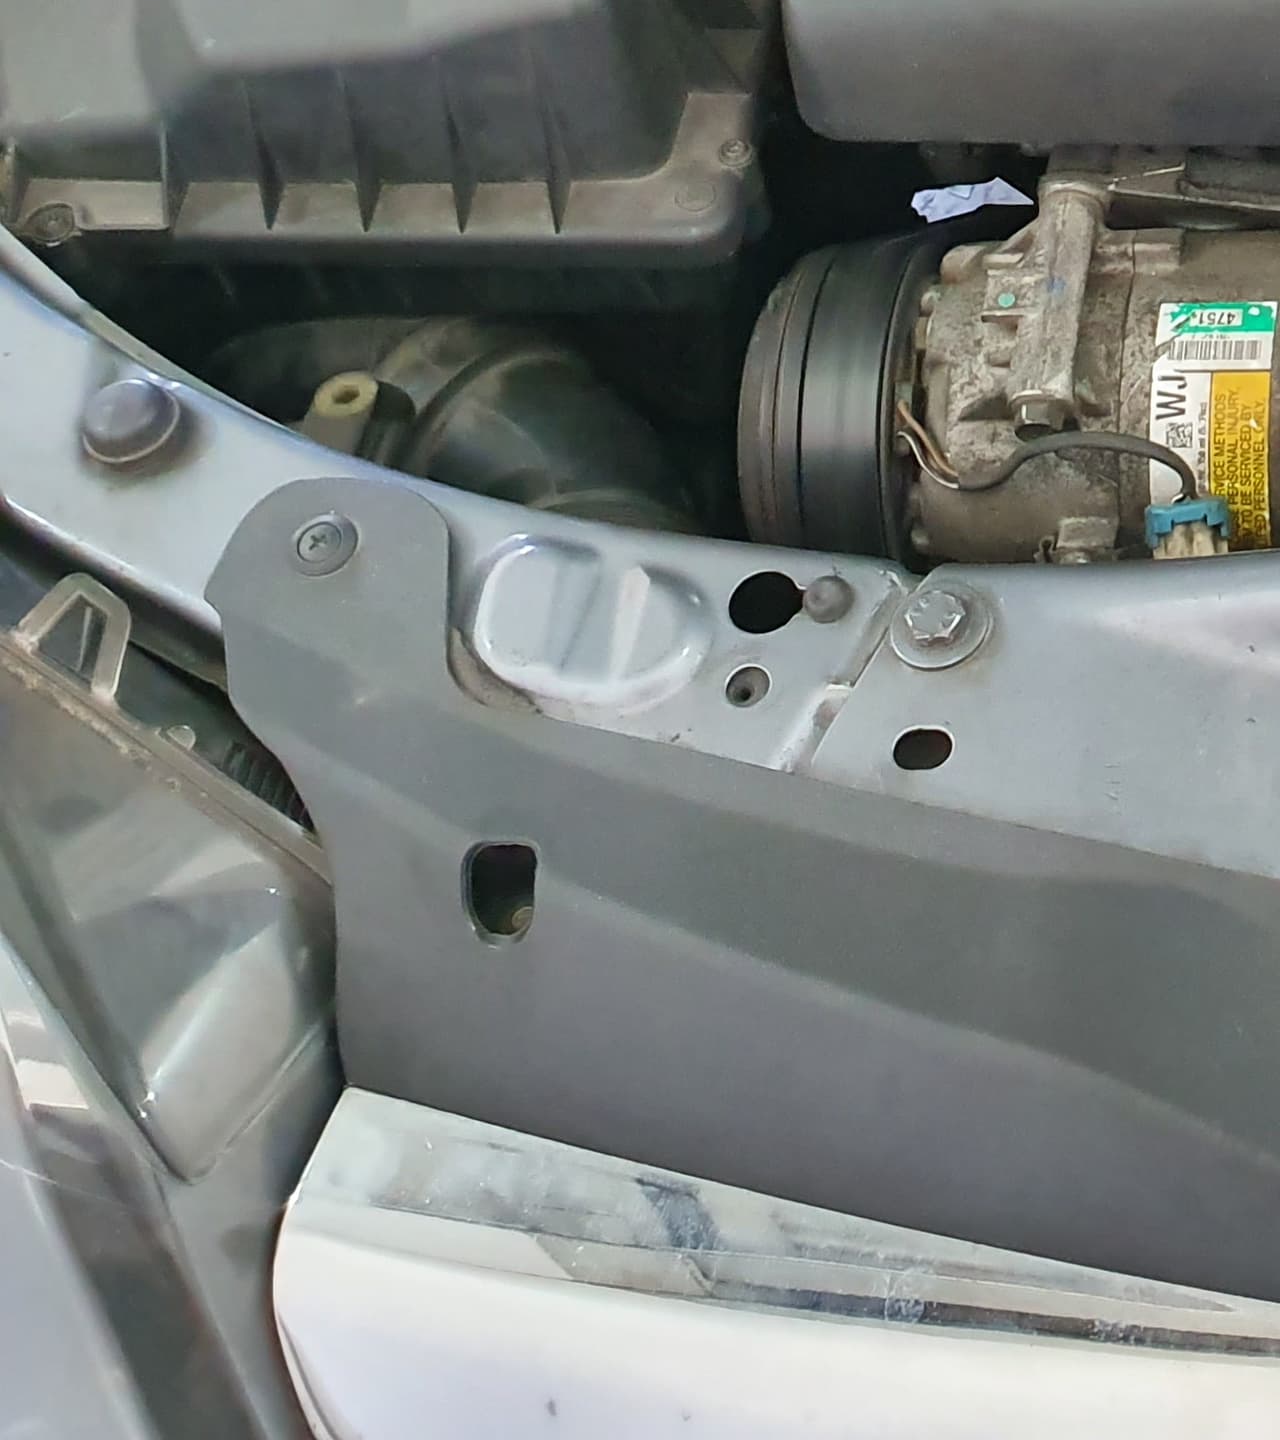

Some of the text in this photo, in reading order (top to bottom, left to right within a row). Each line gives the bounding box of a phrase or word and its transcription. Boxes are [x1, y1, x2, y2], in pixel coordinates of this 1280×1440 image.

[1155, 375, 1188, 420] WJ
[1240, 404, 1251, 421] BY
[1213, 393, 1226, 497] RVICE METHODS
[1226, 439, 1239, 505] PERSONAL
[1240, 425, 1252, 487] SERVICED
[1253, 439, 1265, 511] PERSONNEL
[1240, 490, 1252, 506] BE
